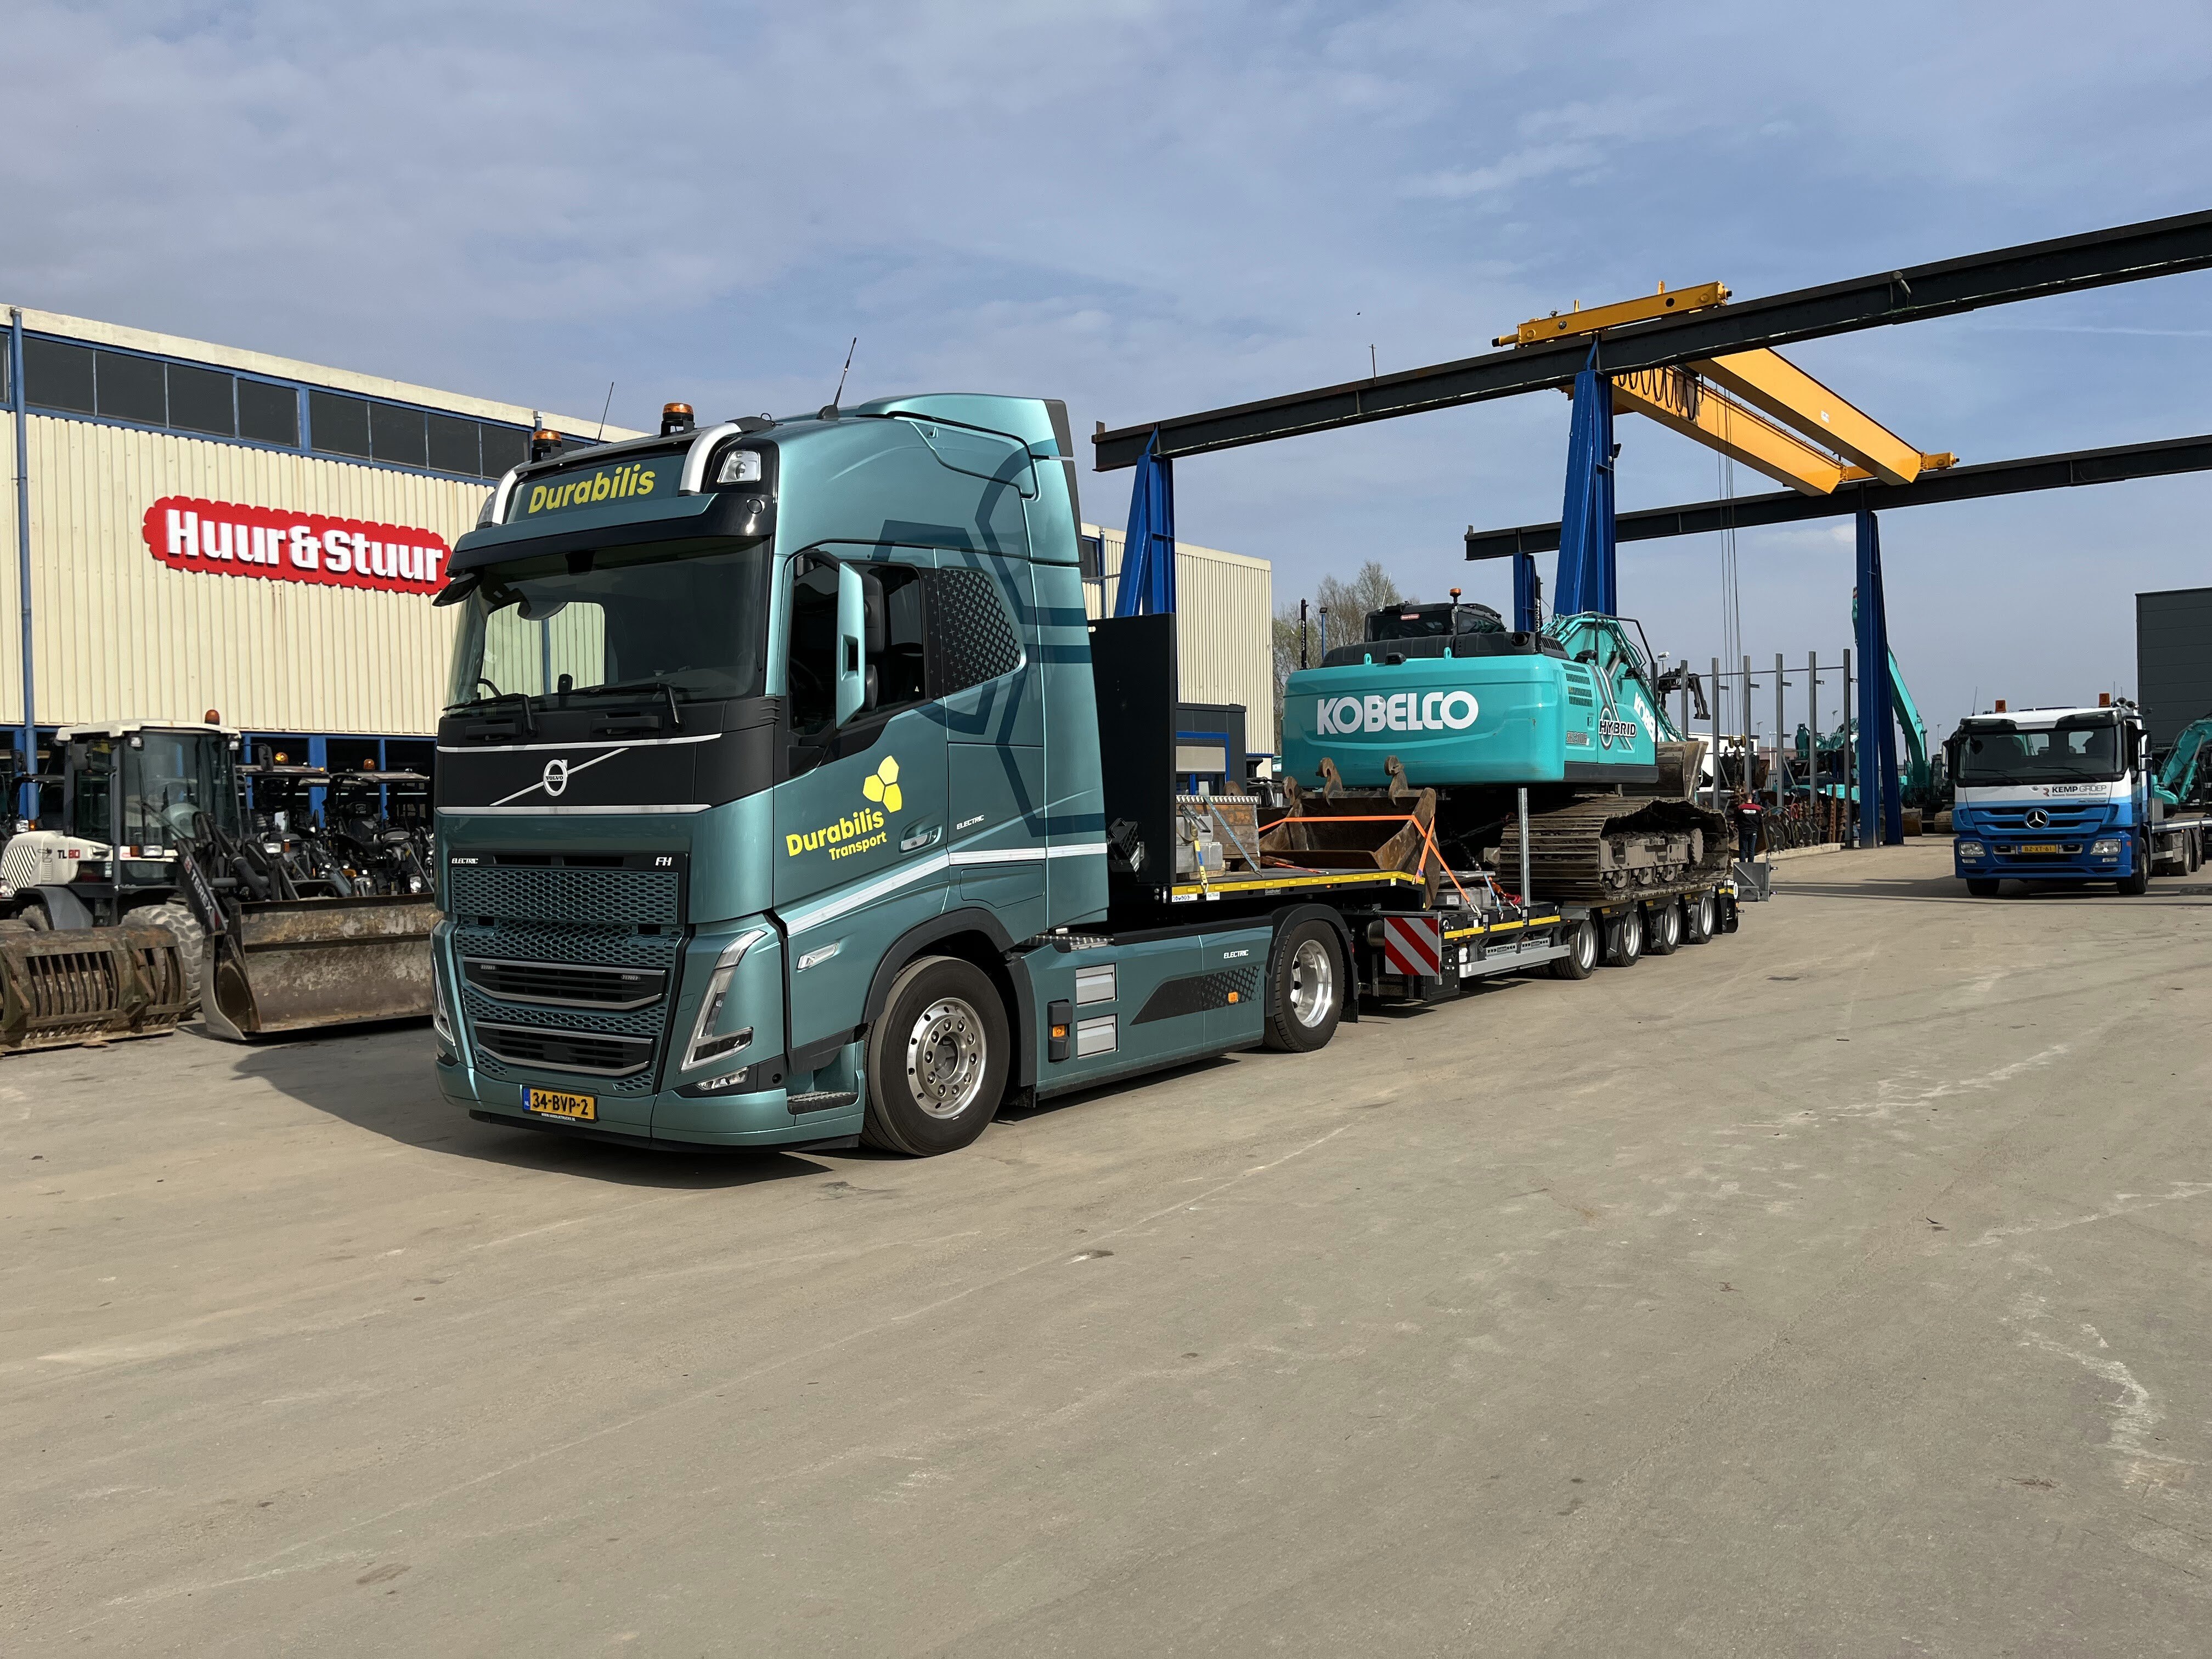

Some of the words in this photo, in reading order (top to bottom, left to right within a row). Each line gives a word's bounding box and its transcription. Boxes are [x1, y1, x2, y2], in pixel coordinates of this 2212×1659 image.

[528, 464, 656, 514] Durabilis
[166, 509, 443, 582] Huur&Stuur
[1317, 691, 1479, 735] KOBELCO
[1599, 720, 1637, 737] HYBRID
[1634, 692, 1665, 742] KOBE
[786, 808, 884, 857] Durabilis
[956, 815, 984, 830] ELECTRIC
[655, 857, 672, 866] FH
[829, 831, 887, 860] Transport
[191, 868, 213, 916] TEREX
[1223, 949, 1249, 959] ELECTRIC
[533, 1092, 589, 1116] 34-BVP-2
